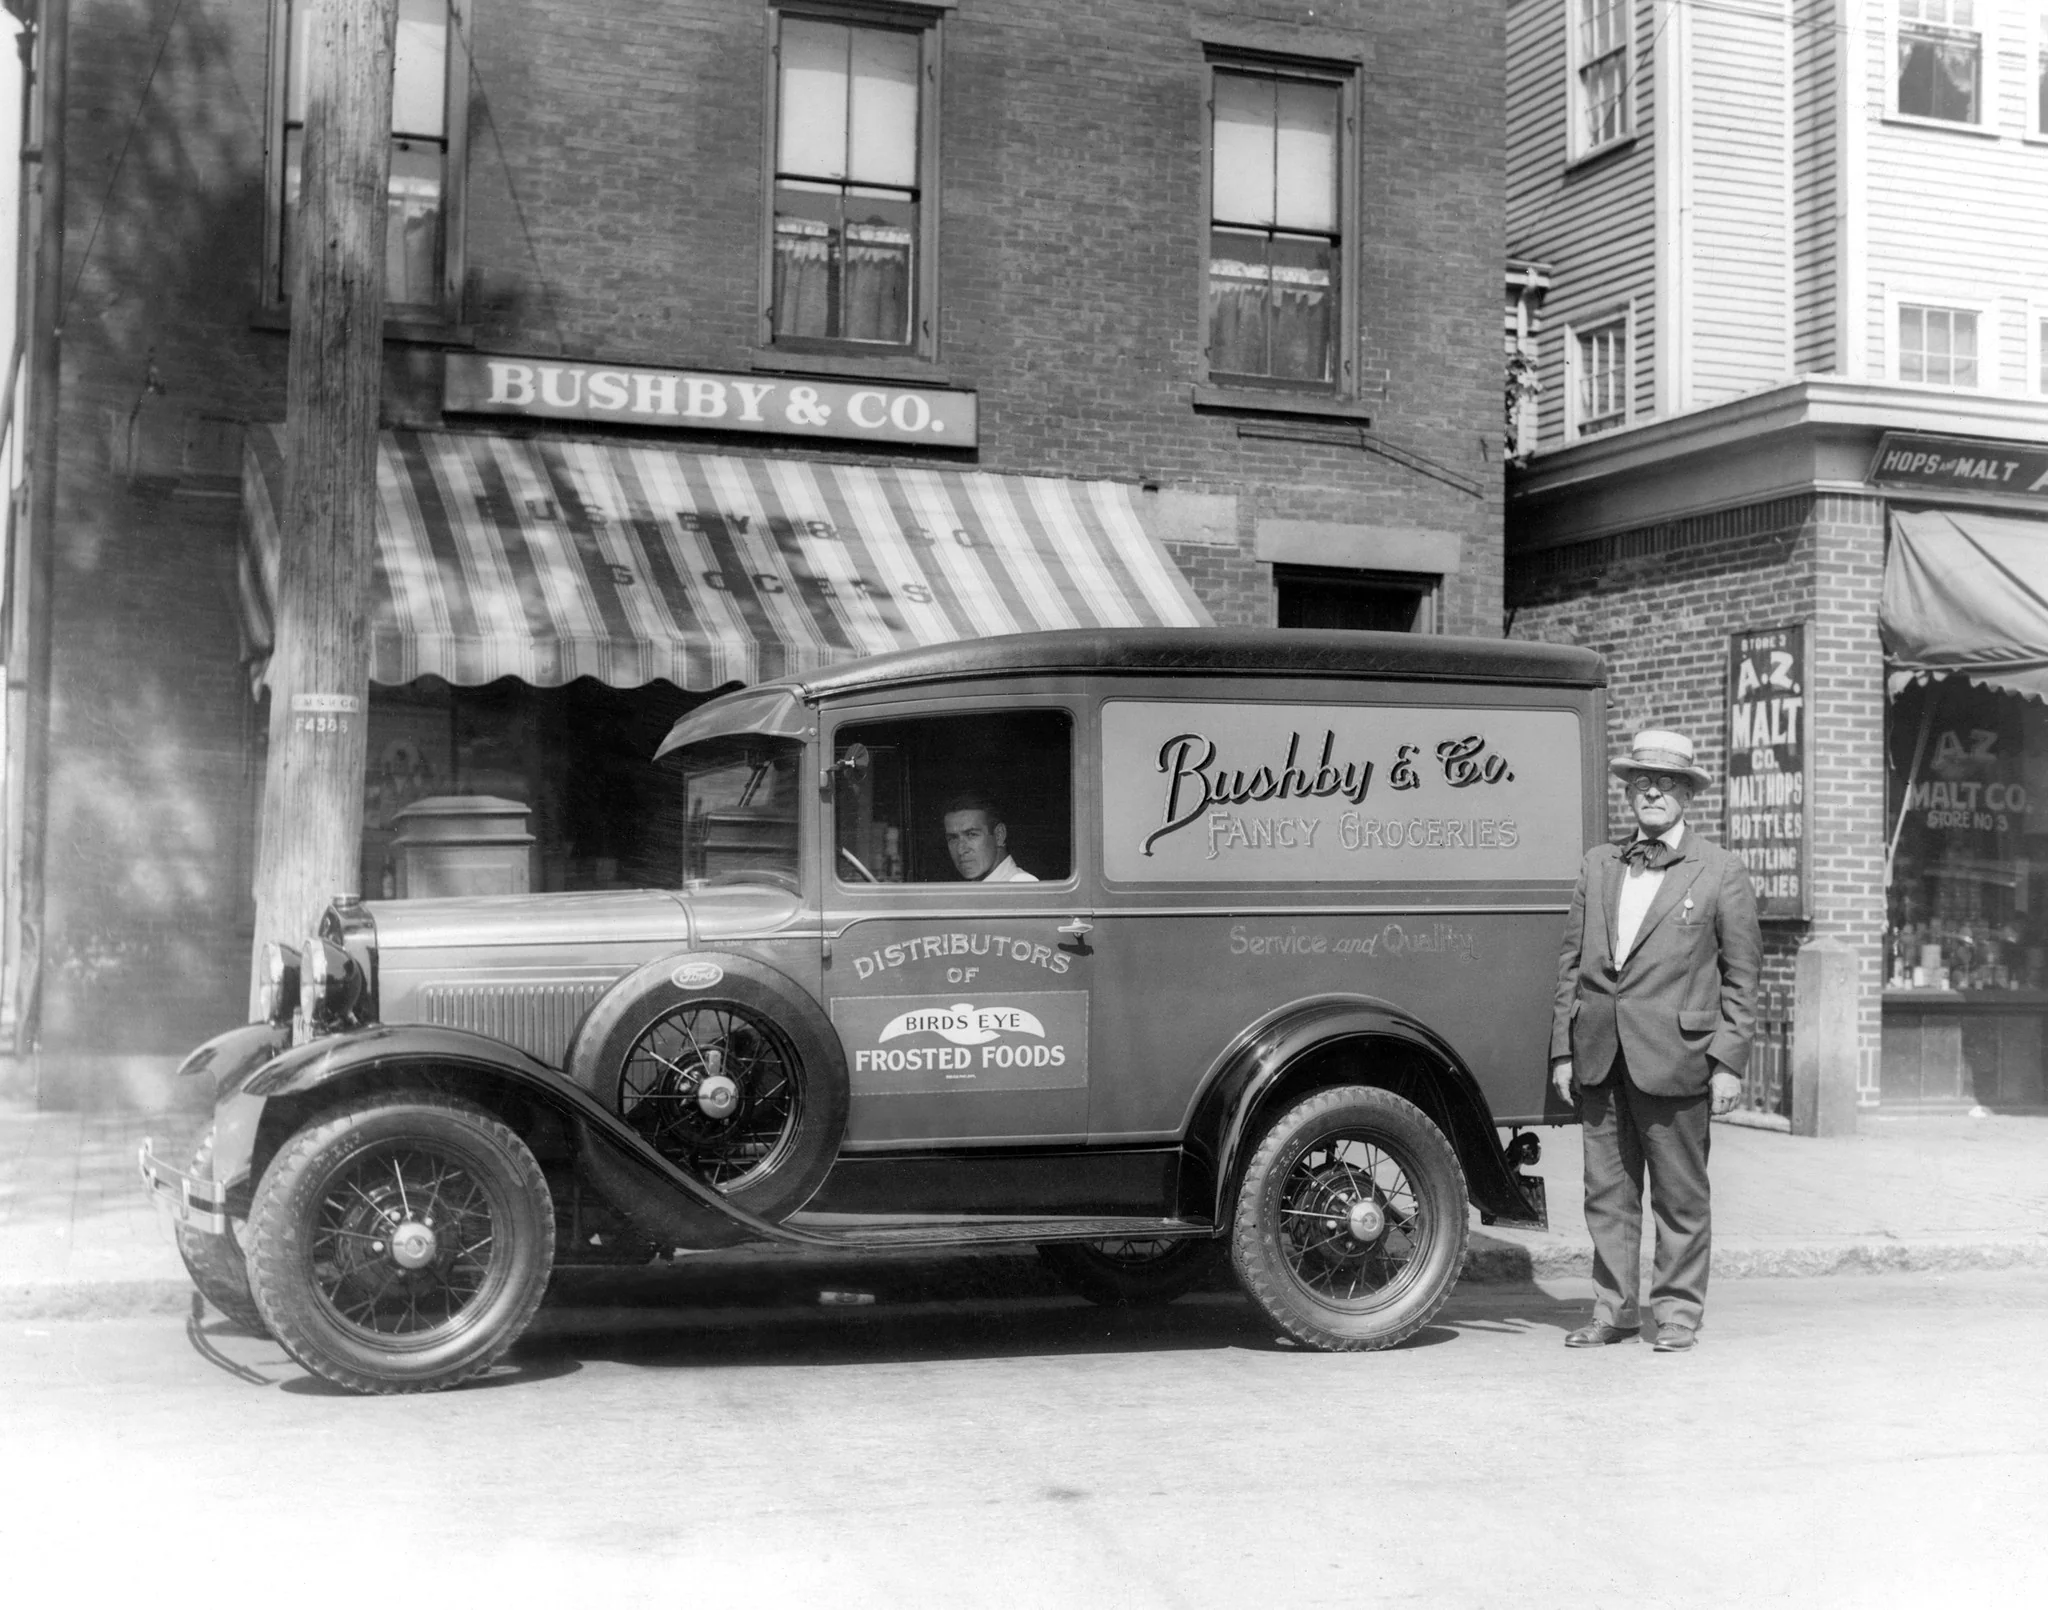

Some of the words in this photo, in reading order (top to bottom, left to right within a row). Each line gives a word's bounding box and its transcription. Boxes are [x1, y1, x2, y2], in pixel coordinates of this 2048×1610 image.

[486, 361, 777, 422] BUSHBY
[785, 385, 832, 426] &
[846, 391, 945, 433] CO.
[1881, 450, 1941, 475] HOPS
[1953, 457, 2020, 482] MALT
[1732, 697, 1803, 750] MALT
[1751, 748, 1780, 770] CO.
[1138, 729, 1374, 857] Bushby
[1387, 742, 1421, 789] &
[1434, 734, 1516, 788] Co.
[1908, 780, 1982, 811] MALT
[1205, 810, 1321, 860] FANCY
[1337, 810, 1521, 851] GROCERIES
[1730, 811, 1802, 840] BOTTLES
[1926, 810, 1972, 829] STORE
[1731, 846, 1797, 871] OTTLING
[852, 933, 1073, 981] DISTRIBUTORS
[1229, 924, 1328, 956] Service
[1331, 933, 1379, 958] and
[1381, 922, 1482, 962] Quality
[946, 966, 980, 984] OF
[906, 1014, 969, 1031] BIRDS
[978, 1013, 1021, 1029] EYE
[855, 1047, 972, 1072] FROSTED
[982, 1045, 1067, 1069] FOODS
